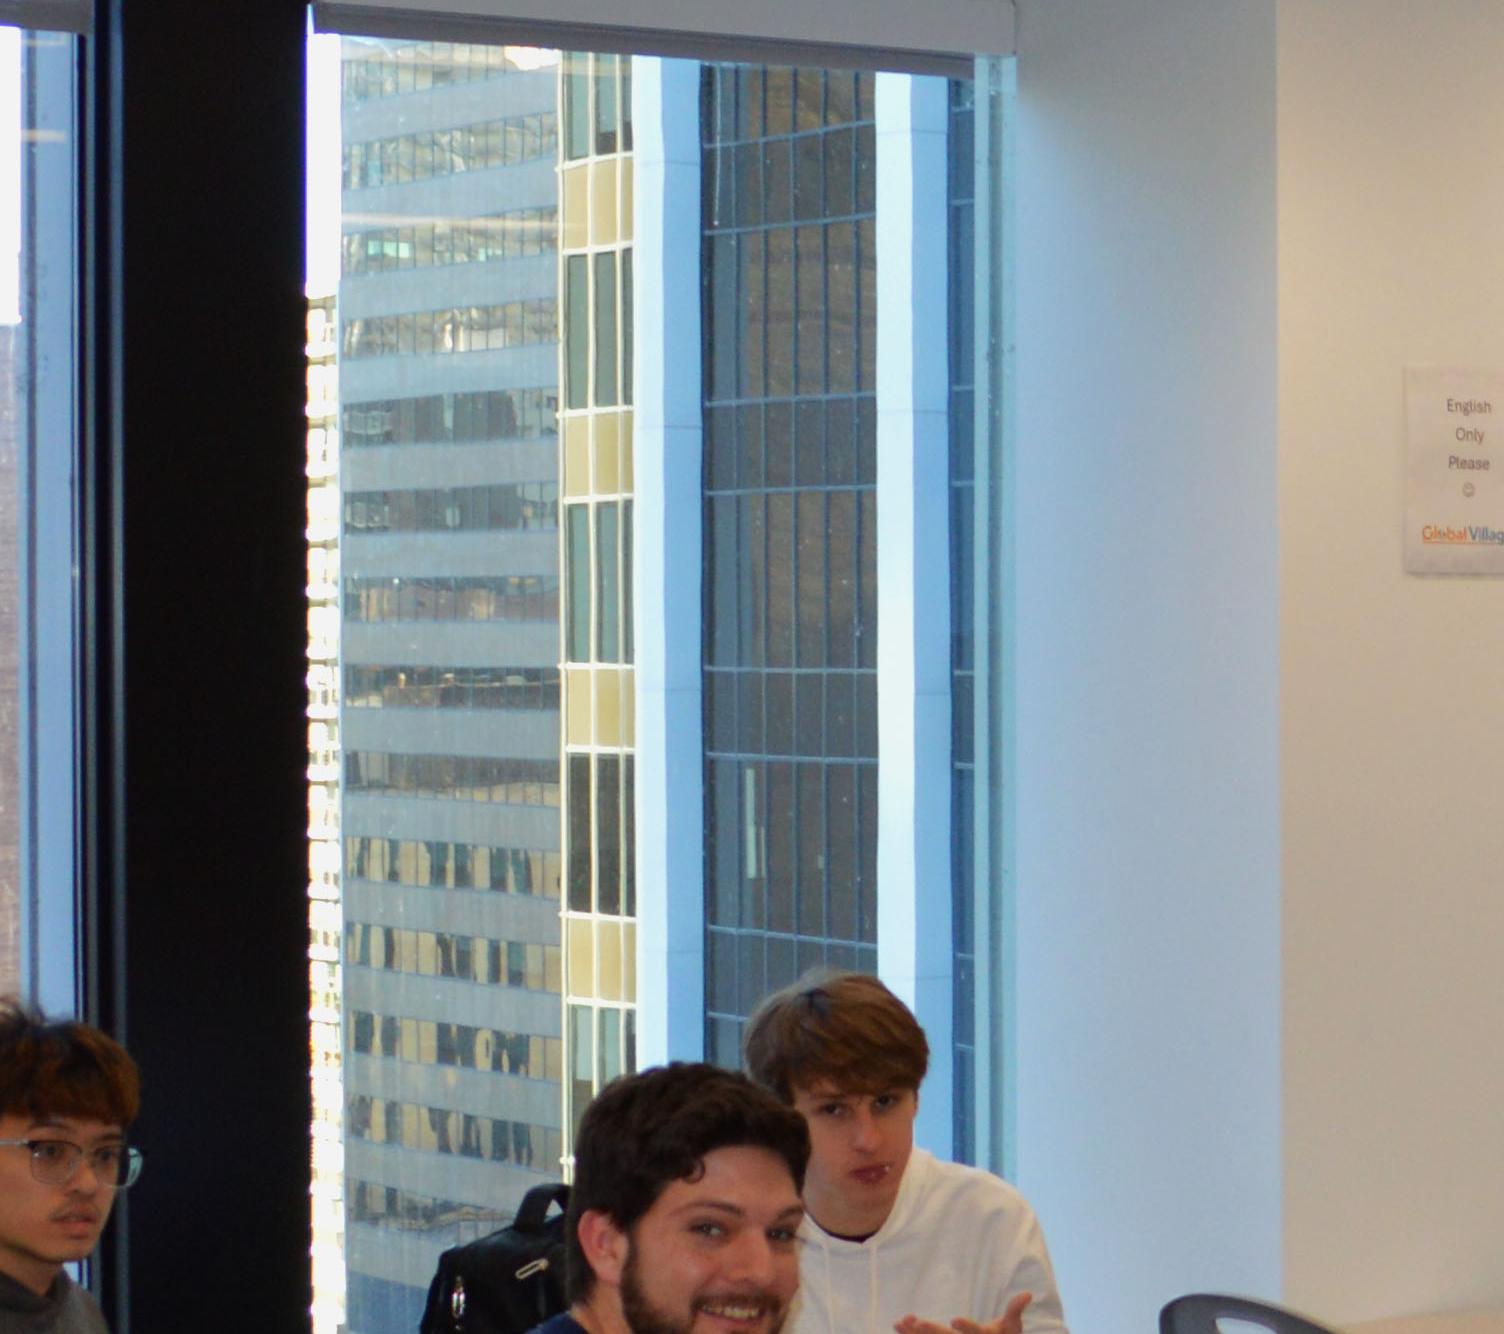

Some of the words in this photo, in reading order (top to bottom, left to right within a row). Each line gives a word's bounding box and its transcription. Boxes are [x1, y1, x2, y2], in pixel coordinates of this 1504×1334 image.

[1446, 398, 1492, 417] English
[1455, 426, 1486, 445] Only
[1448, 455, 1491, 471] Please
